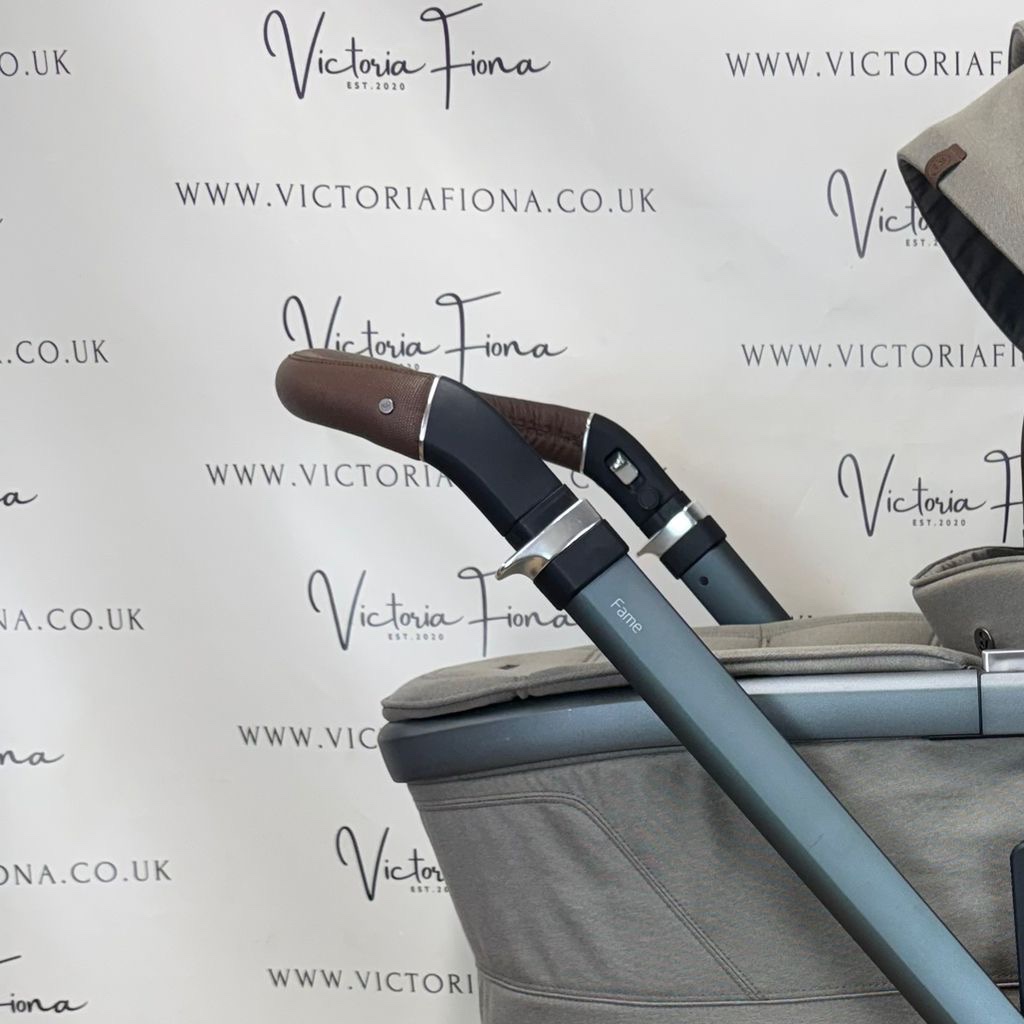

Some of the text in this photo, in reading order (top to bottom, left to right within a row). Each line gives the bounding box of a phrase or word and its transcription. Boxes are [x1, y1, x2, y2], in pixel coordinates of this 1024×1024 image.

[263, 3, 551, 110] Victoria Fiona
[346, 81, 406, 91] EST.2020
[174, 181, 658, 214] WWW.VICTORIAFIONA.CO.UK
[0, 339, 109, 365] .CO.UK
[435, 291, 568, 384] Fiona
[837, 453, 986, 537] Victoria
[912, 519, 966, 527] EST.2020
[308, 567, 577, 657] Victoria Fiona
[610, 598, 643, 634] Fame
[388, 632, 445, 641] EST.2020
